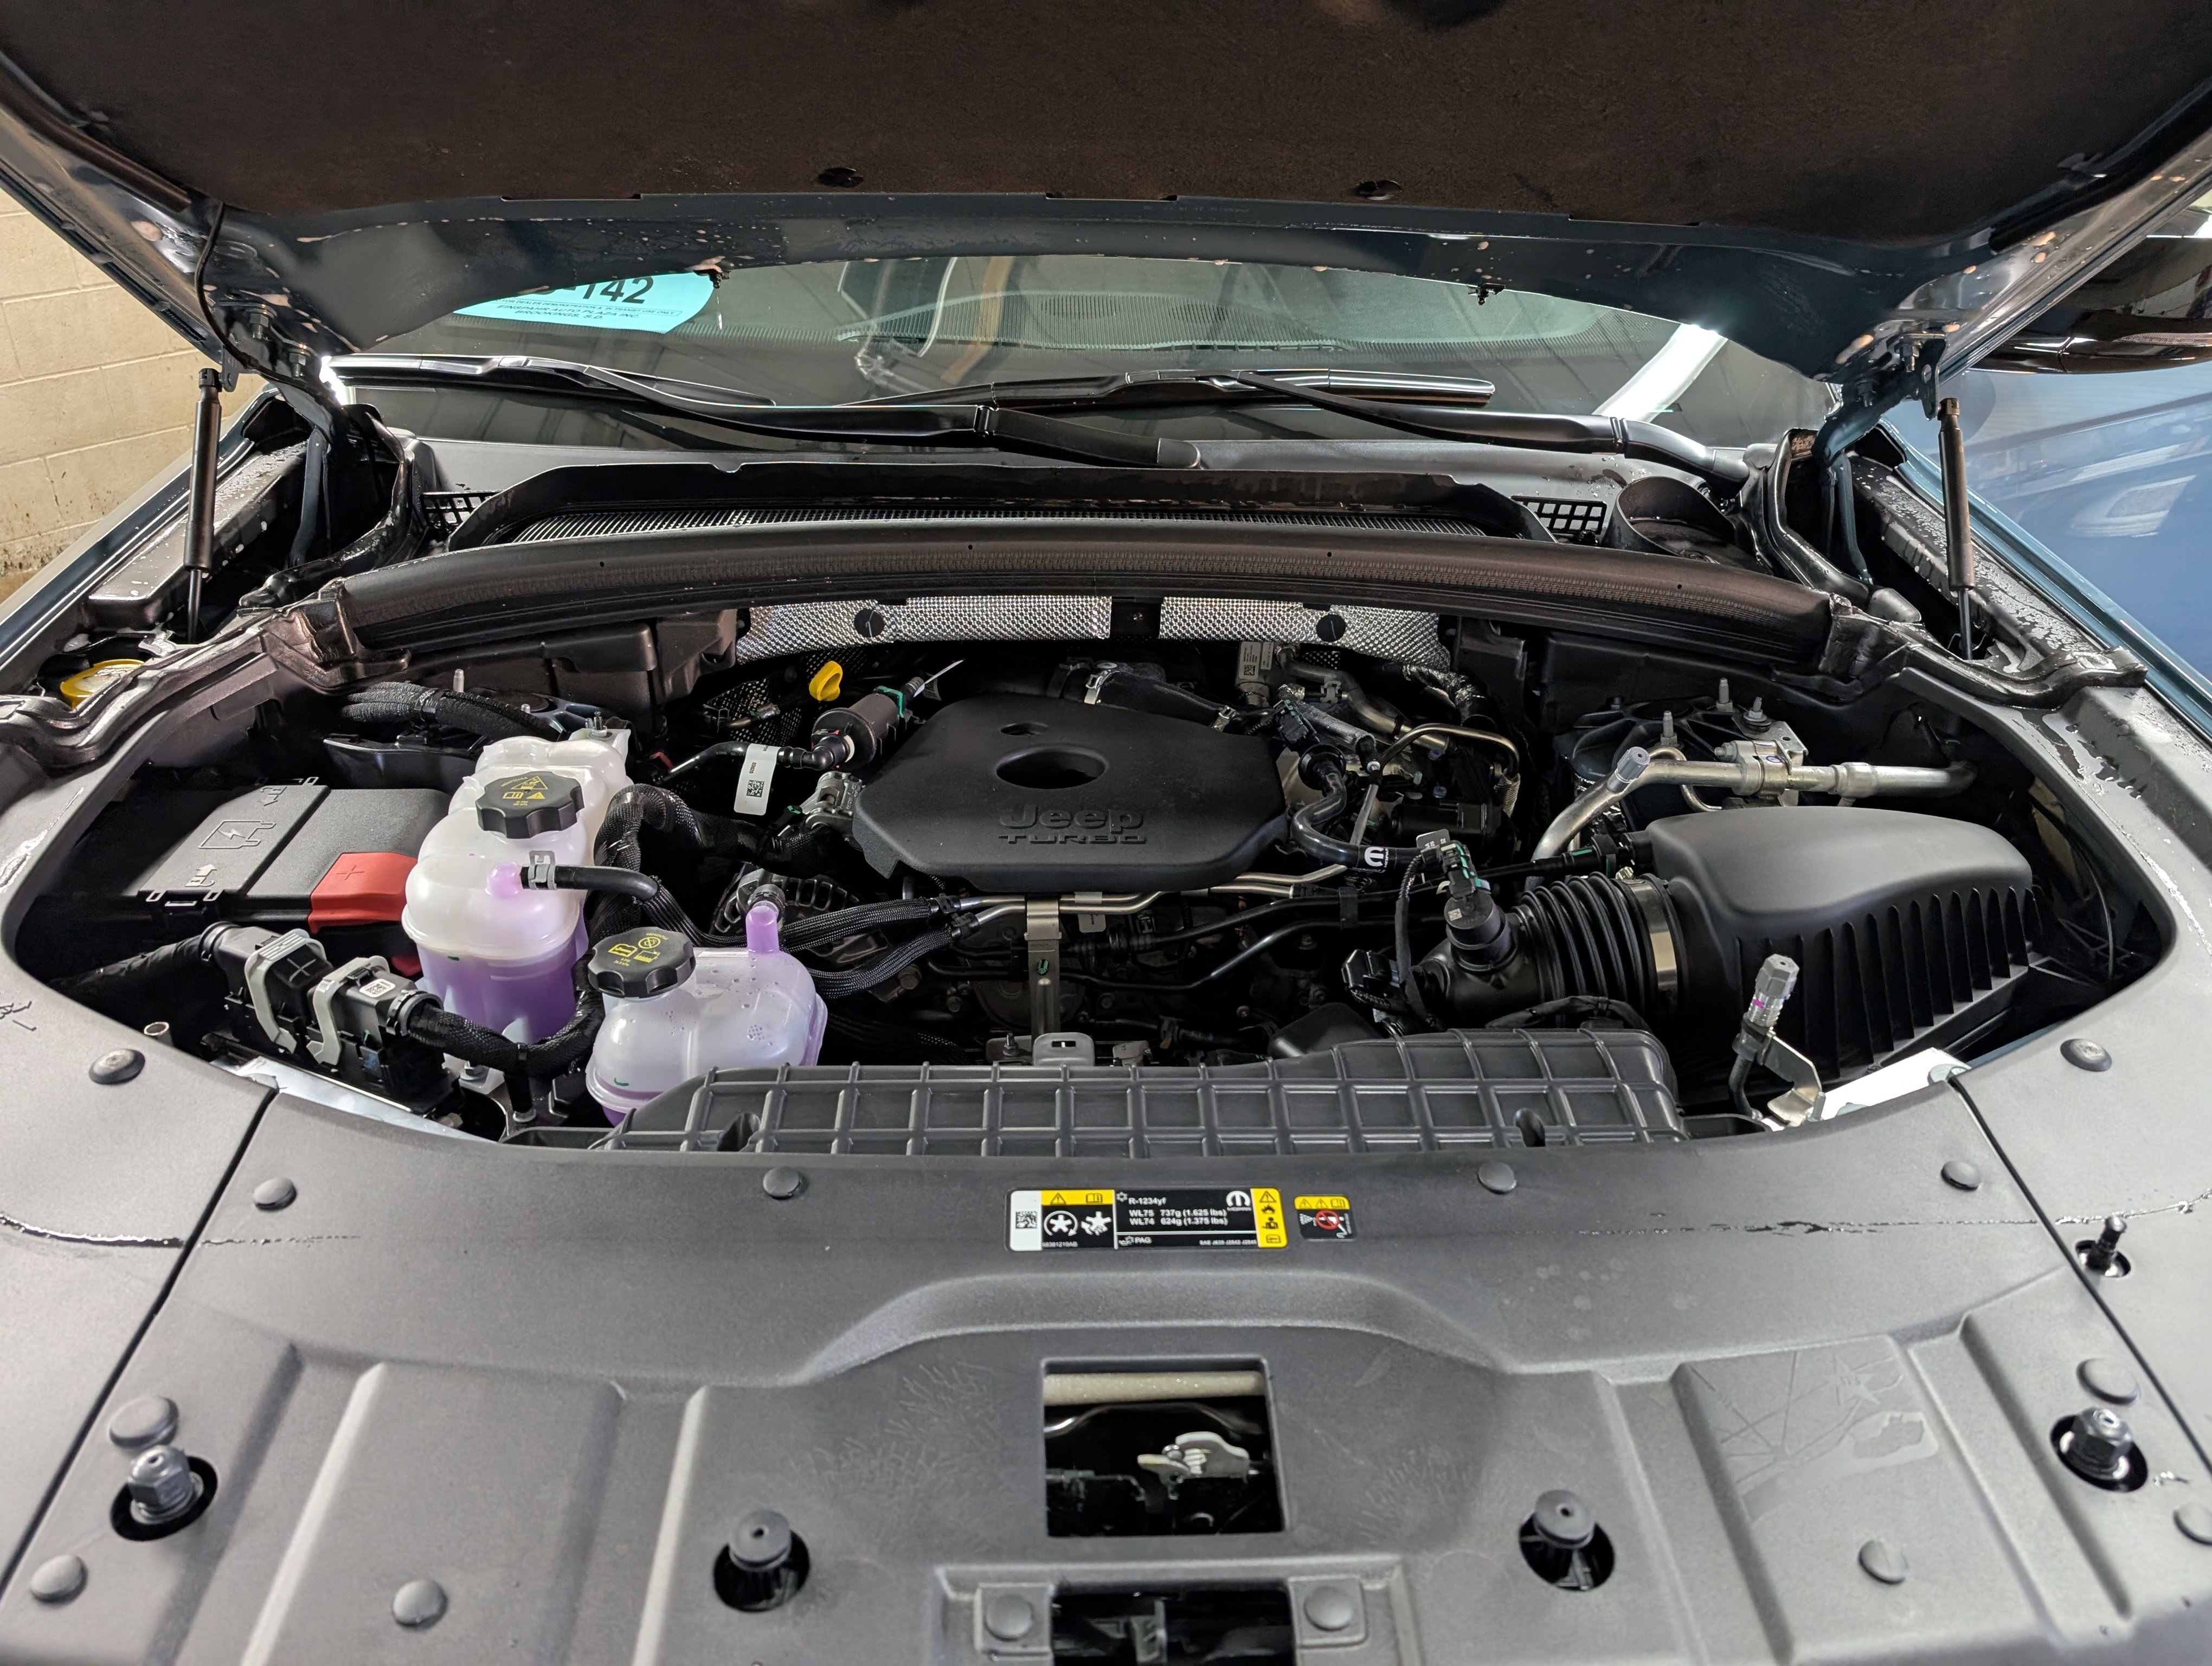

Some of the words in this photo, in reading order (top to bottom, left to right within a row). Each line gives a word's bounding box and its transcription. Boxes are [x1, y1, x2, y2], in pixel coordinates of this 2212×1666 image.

[999, 804, 1144, 834] Jeep
[998, 834, 1147, 845] TURBO
[1128, 1197, 1167, 1206] R-1234yf
[1160, 1209, 1182, 1218] 737g
[1182, 1209, 1210, 1218] (1.625
[1210, 1208, 1227, 1217] lbs)
[1160, 1218, 1182, 1226] 624g
[1184, 1217, 1210, 1226] (1.375
[1211, 1217, 1229, 1226] lbs)
